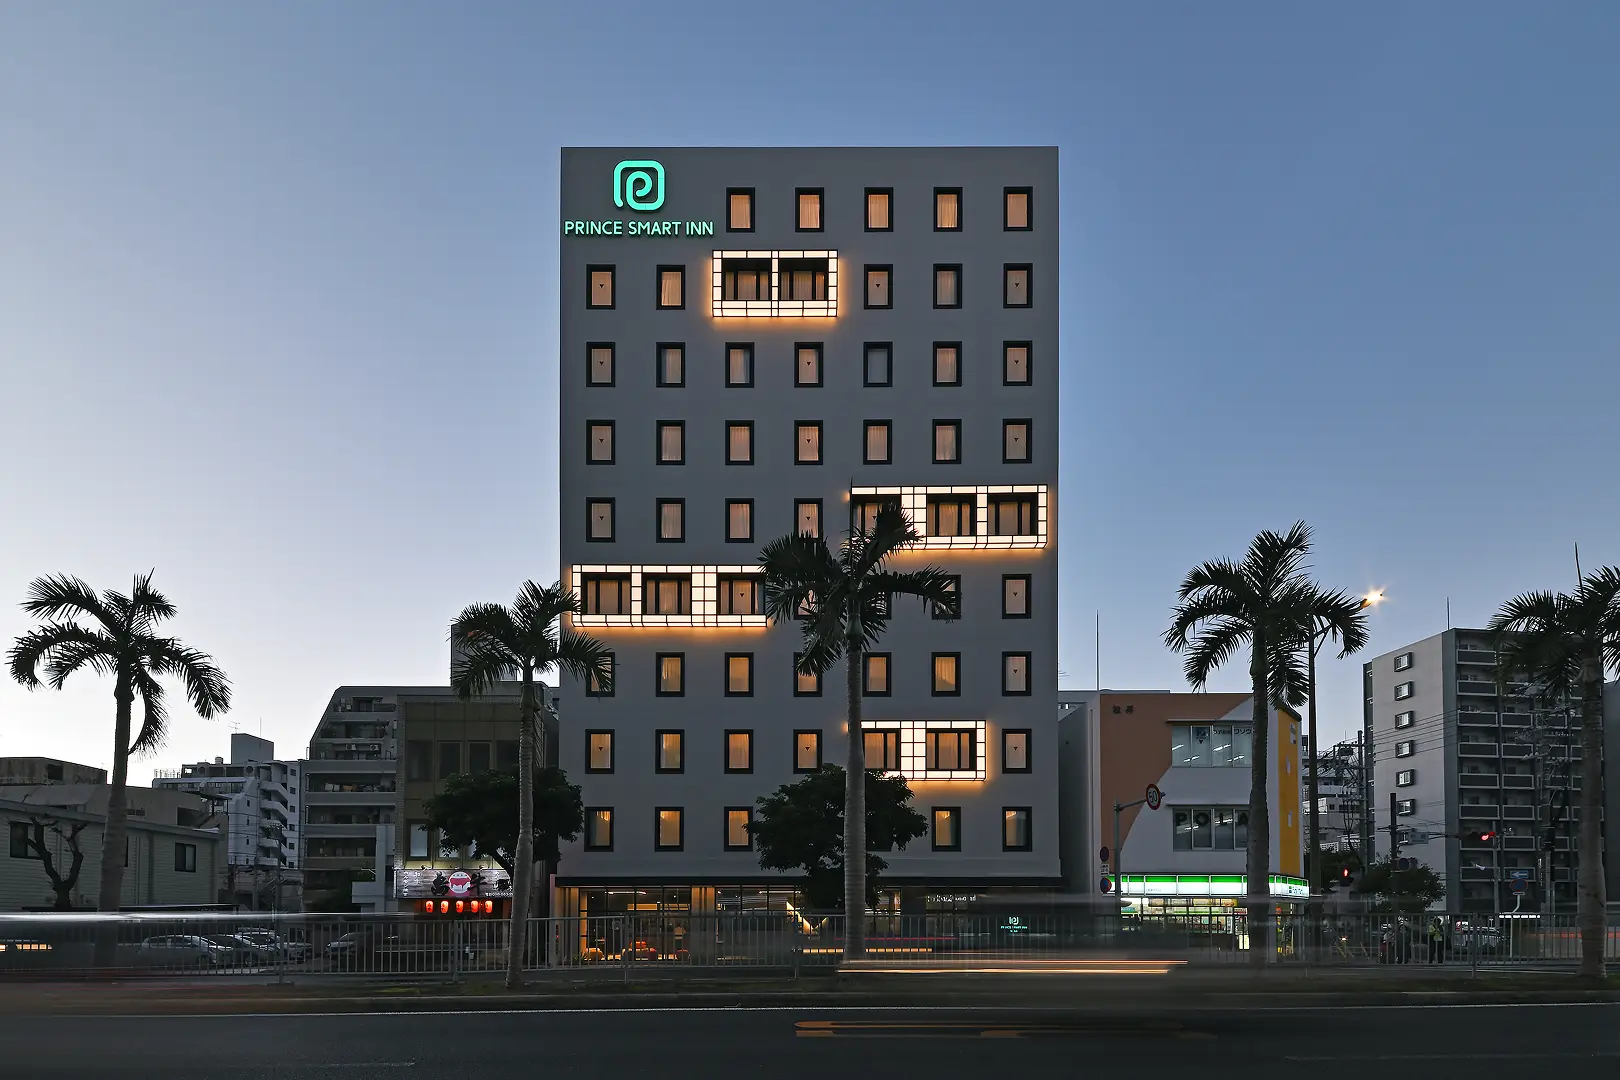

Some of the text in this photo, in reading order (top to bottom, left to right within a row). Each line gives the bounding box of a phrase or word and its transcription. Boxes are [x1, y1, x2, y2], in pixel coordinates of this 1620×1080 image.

[564, 221, 715, 235] PRINCE SMART INN
[1148, 790, 1158, 803] 50
[1175, 812, 1249, 827] POLA
